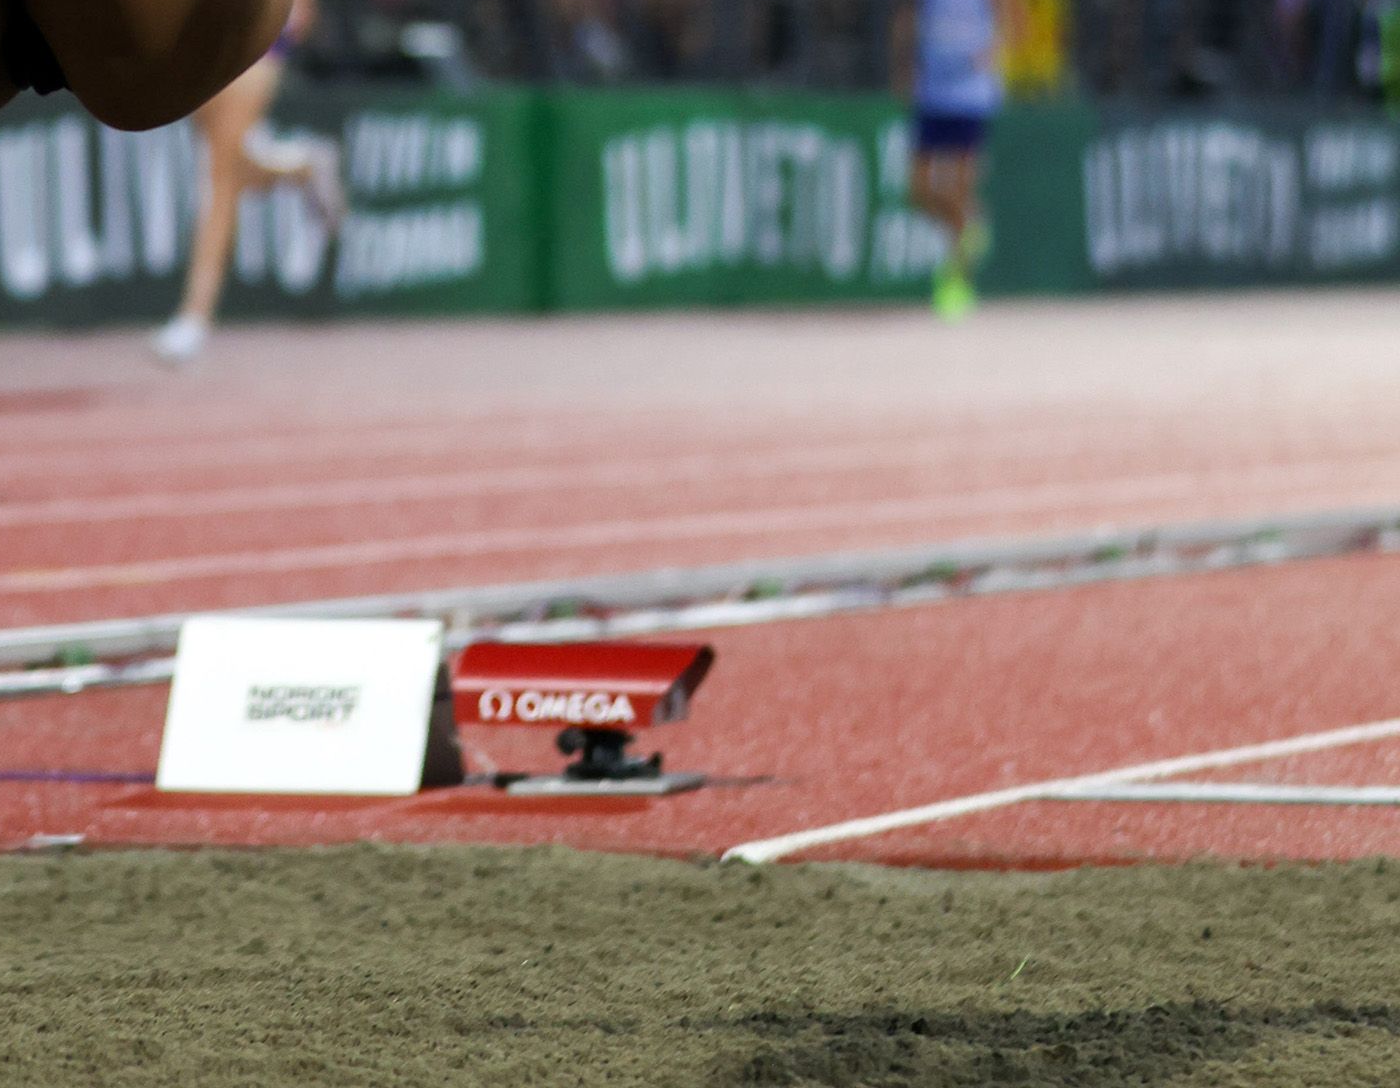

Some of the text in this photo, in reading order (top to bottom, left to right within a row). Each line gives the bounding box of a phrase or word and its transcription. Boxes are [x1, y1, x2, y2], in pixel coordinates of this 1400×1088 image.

[249, 684, 362, 700] NORDIC
[247, 700, 357, 721] SPORT
[515, 690, 635, 723] OMEGA
